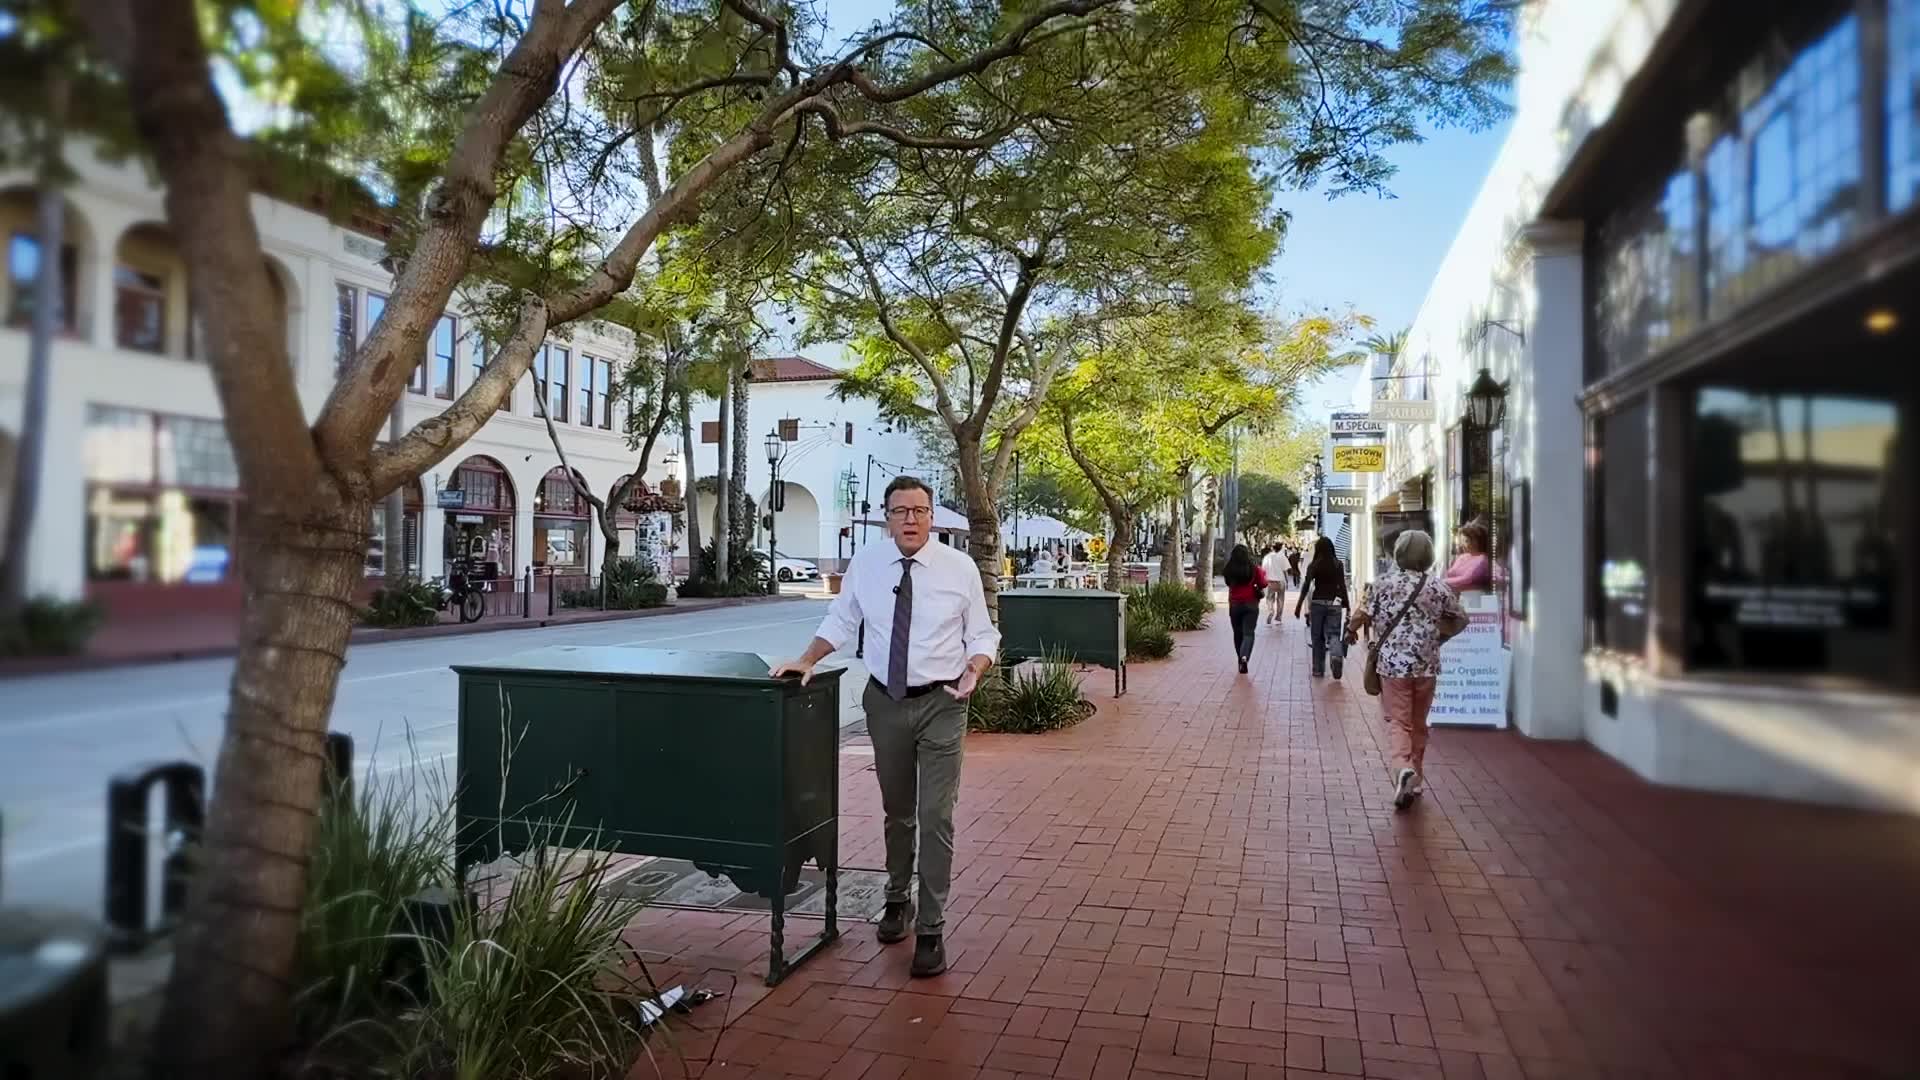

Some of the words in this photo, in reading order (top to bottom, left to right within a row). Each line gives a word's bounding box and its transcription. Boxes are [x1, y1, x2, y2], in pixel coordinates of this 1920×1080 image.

[1335, 448, 1382, 459] DOWNTOWN
[1329, 497, 1364, 507] vuori
[1458, 666, 1498, 676] Organic
[1462, 692, 1487, 702] points
